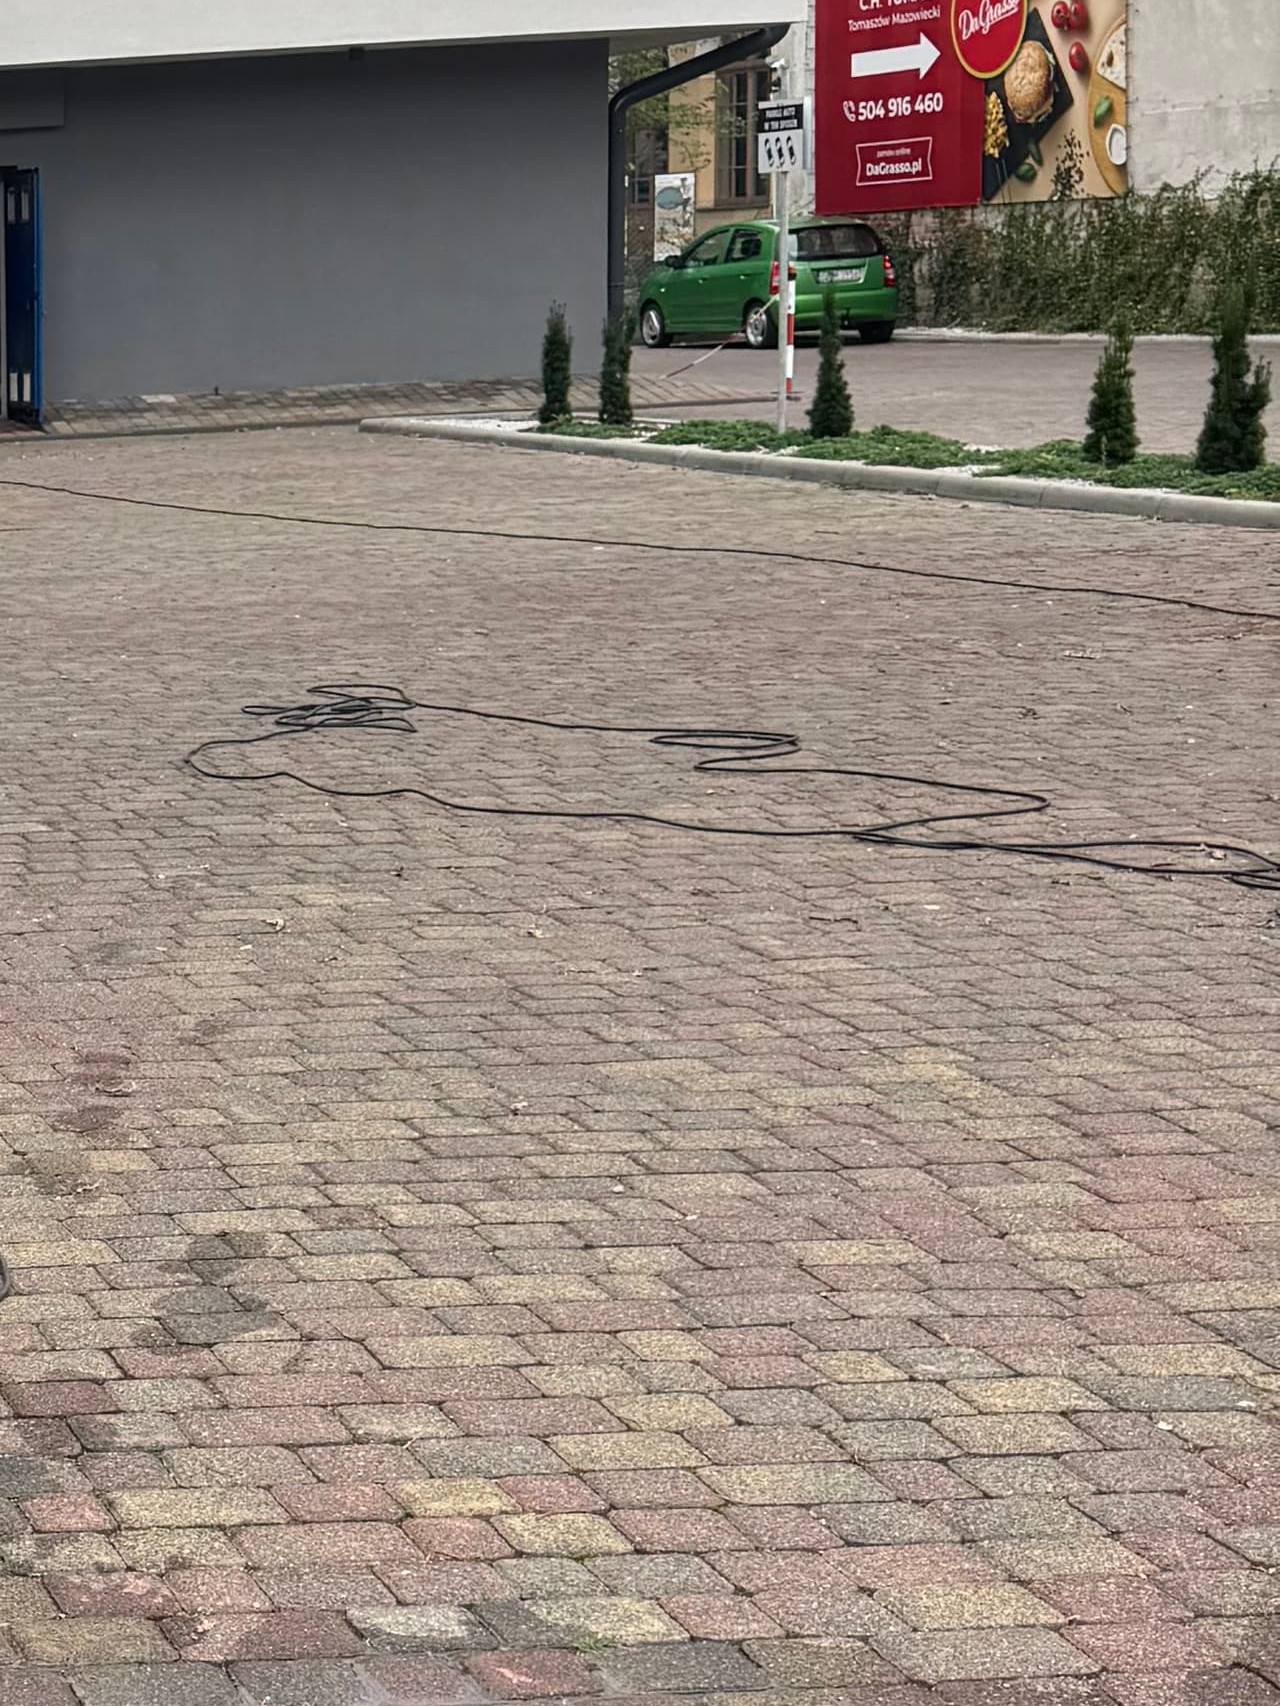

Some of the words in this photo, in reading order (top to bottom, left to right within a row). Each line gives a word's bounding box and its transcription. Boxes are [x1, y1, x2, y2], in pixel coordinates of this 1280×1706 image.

[858, 100, 886, 121] 504
[888, 96, 912, 118] 916
[914, 92, 944, 114] 460
[866, 157, 922, 177] DaGrasso.pl
